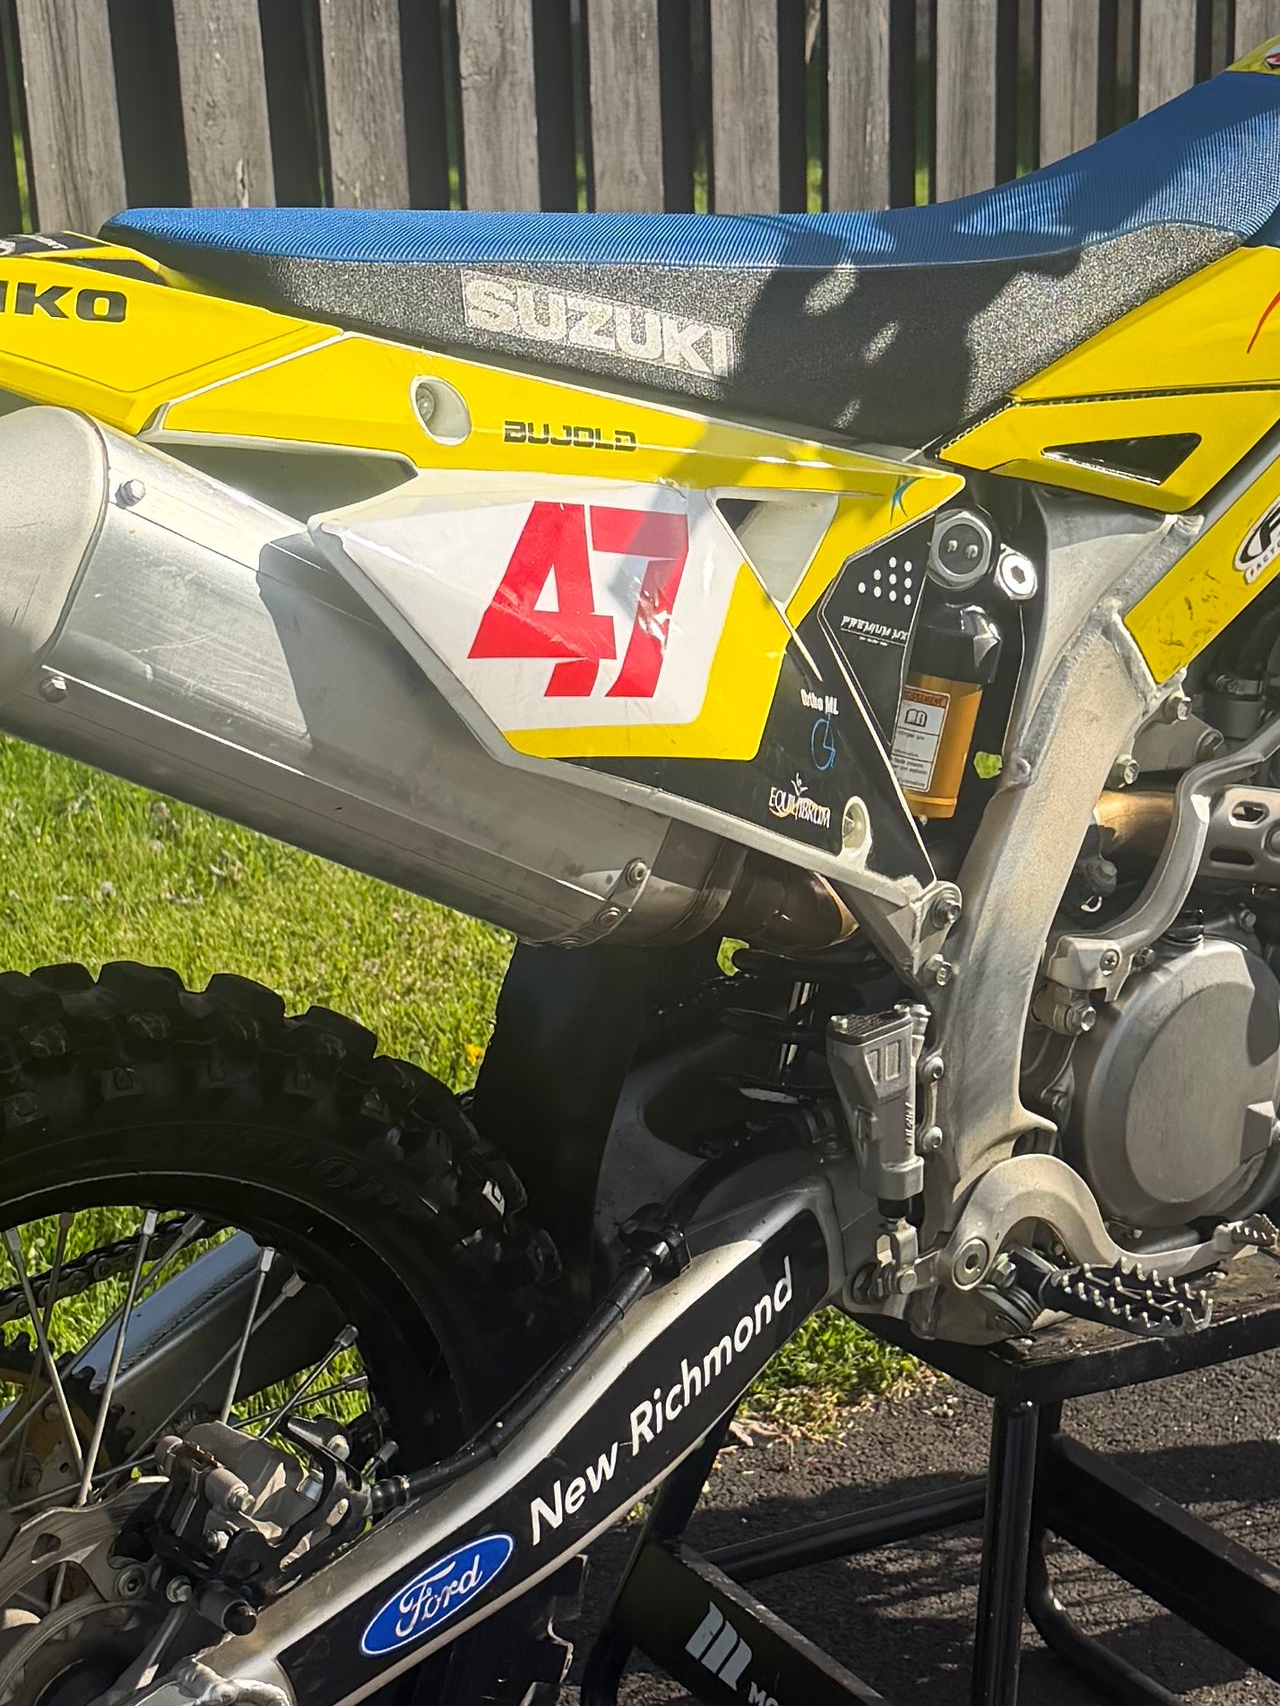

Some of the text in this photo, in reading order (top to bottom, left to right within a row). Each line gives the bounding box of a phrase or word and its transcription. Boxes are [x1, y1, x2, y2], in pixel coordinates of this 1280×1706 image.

[464, 272, 734, 377] SUZUKI
[504, 421, 637, 452] BUJOLD
[467, 501, 689, 697] 47
[530, 1255, 794, 1546] New Richmond
[395, 1554, 484, 1638] Ford
